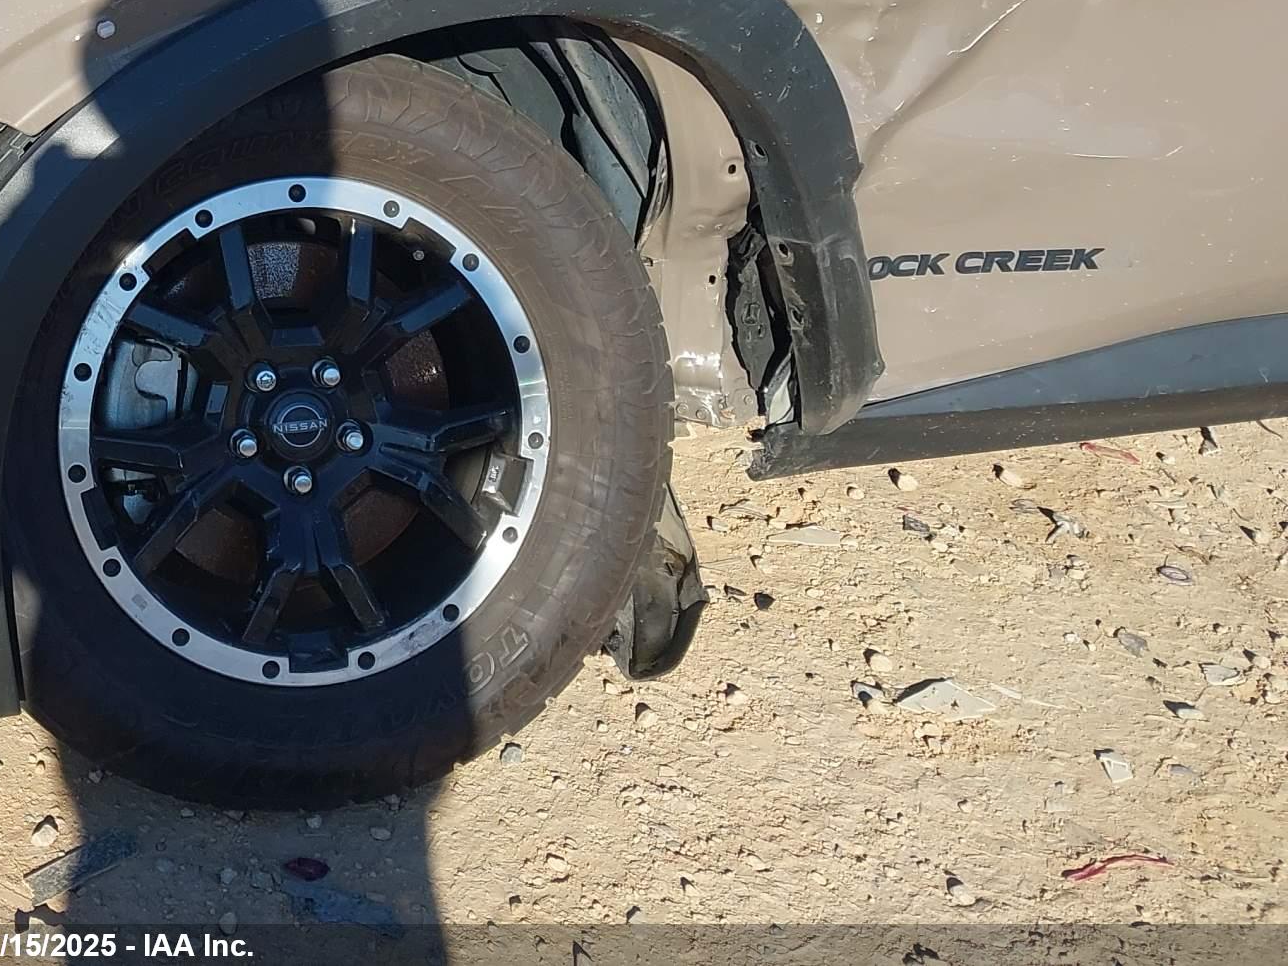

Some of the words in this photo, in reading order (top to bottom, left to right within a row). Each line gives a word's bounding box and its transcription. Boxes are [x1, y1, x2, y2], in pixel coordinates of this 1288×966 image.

[867, 252, 949, 280] OCK
[955, 248, 1105, 274] CREEK
[272, 418, 328, 434] NISSAN
